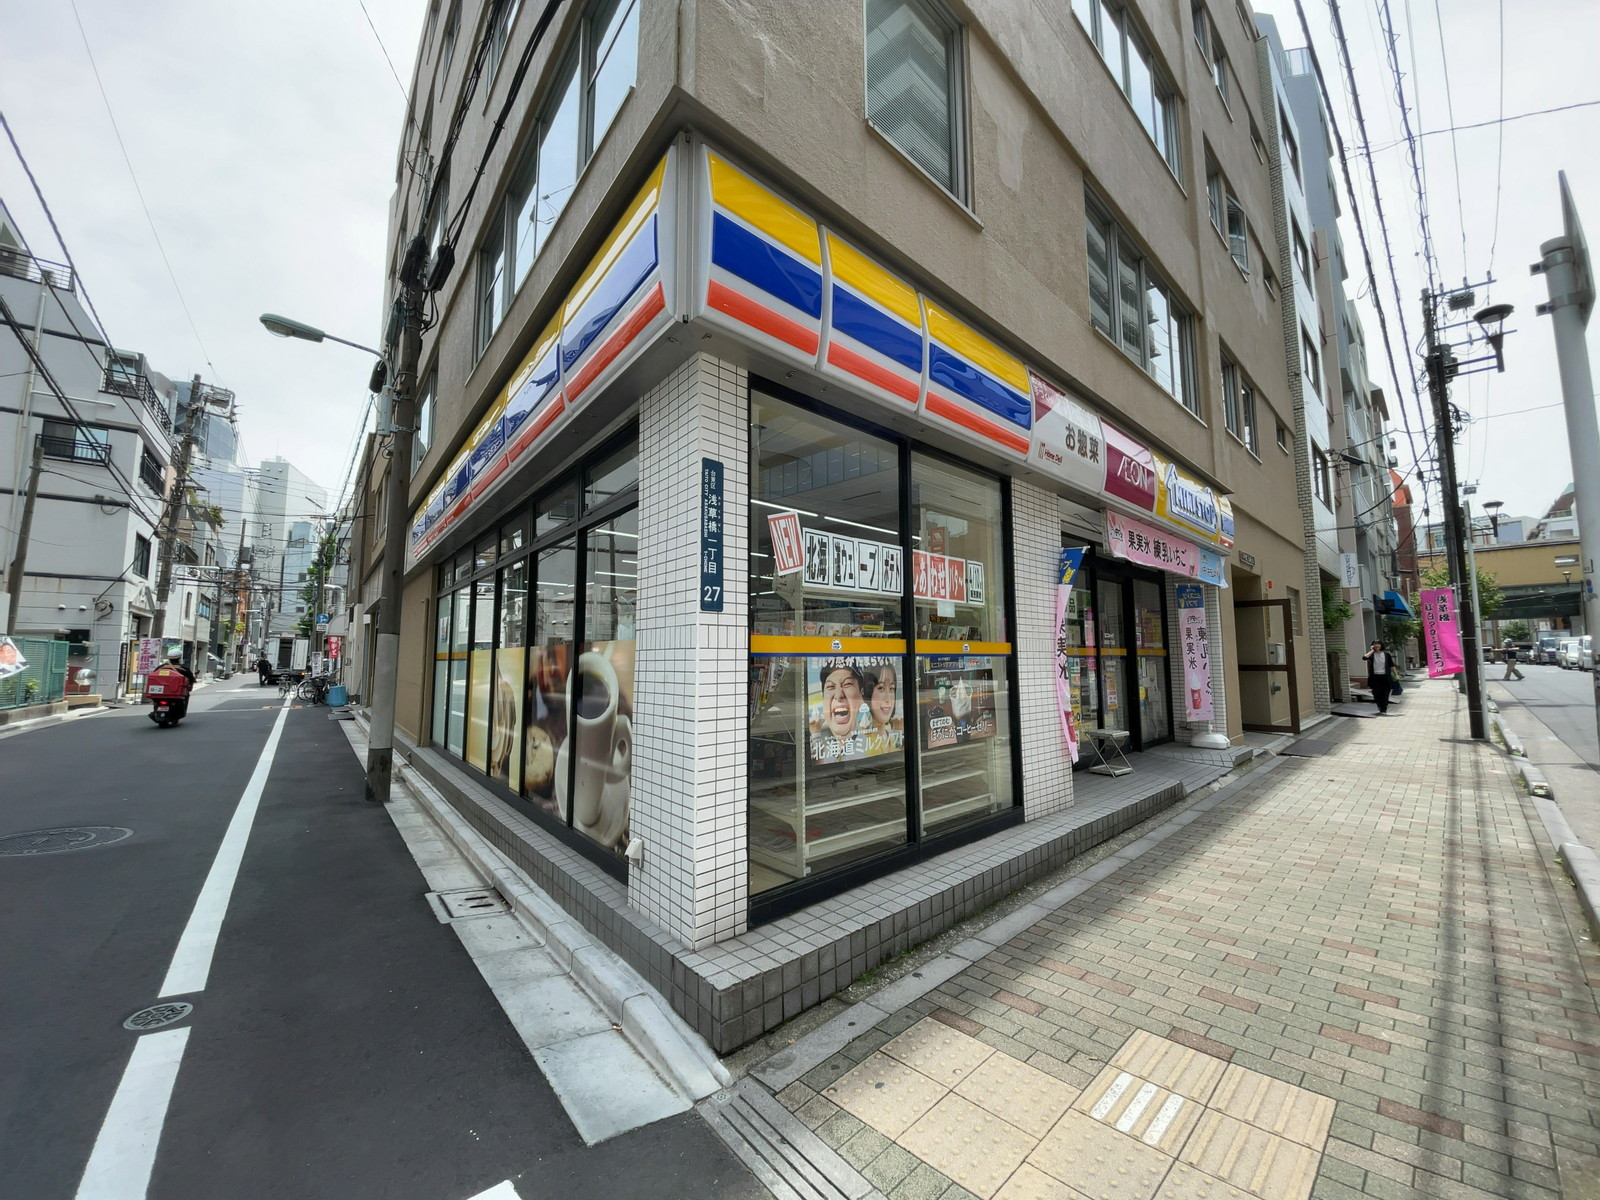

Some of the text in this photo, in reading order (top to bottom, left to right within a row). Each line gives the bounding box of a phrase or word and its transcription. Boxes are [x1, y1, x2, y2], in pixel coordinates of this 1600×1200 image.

[1065, 423, 1099, 464] お惣菜
[770, 517, 800, 569] NEW
[1127, 530, 1151, 555] 果実氷
[1153, 538, 1187, 567] 練乳いちご
[704, 586, 721, 602] 27
[1436, 595, 1450, 622] 浅草橋
[930, 721, 993, 742] ほろにがコーヒーゼリー
[813, 732, 904, 761] 北海道ミルクソフト
